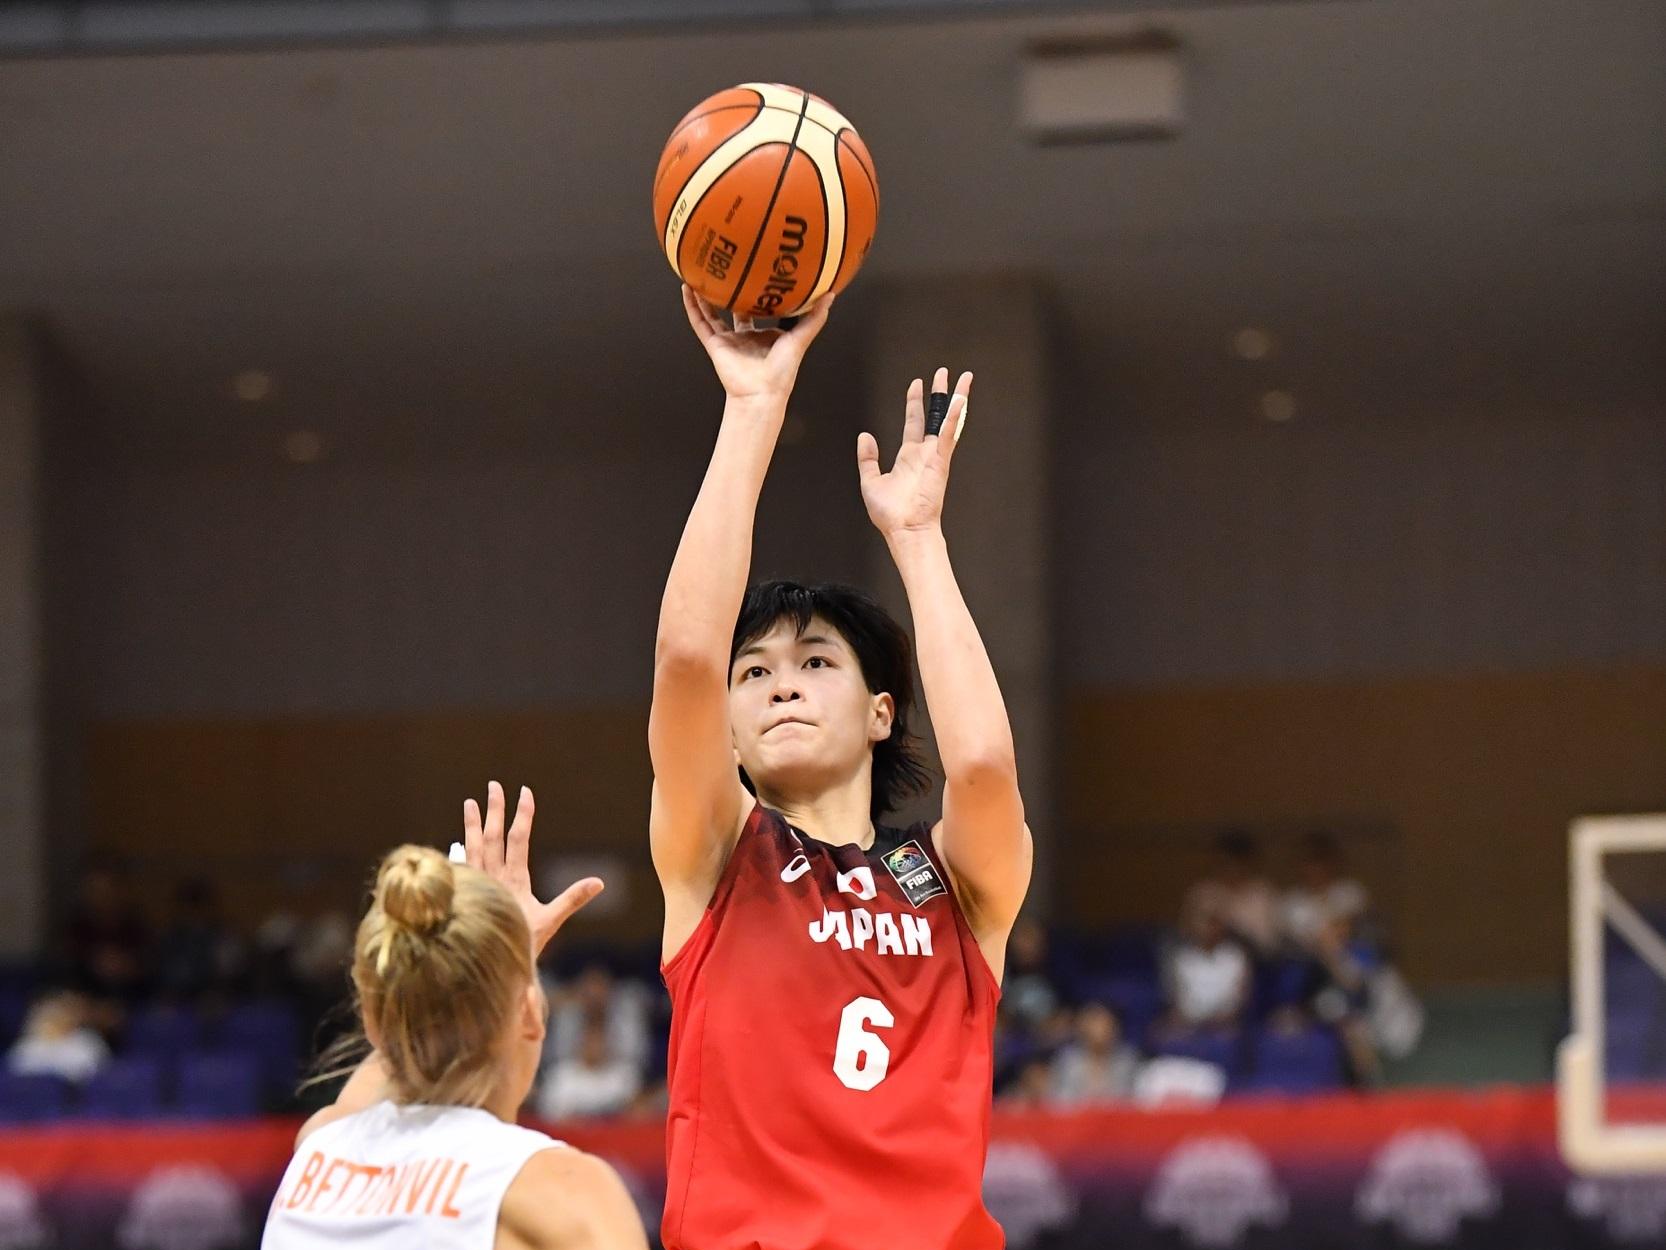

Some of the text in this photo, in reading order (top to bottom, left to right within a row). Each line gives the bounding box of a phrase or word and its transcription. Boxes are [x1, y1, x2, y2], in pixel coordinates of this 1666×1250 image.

[706, 234, 738, 280] FIBA
[905, 870, 933, 890] FIBA
[808, 904, 934, 956] JAPAN
[832, 995, 895, 1092] 6
